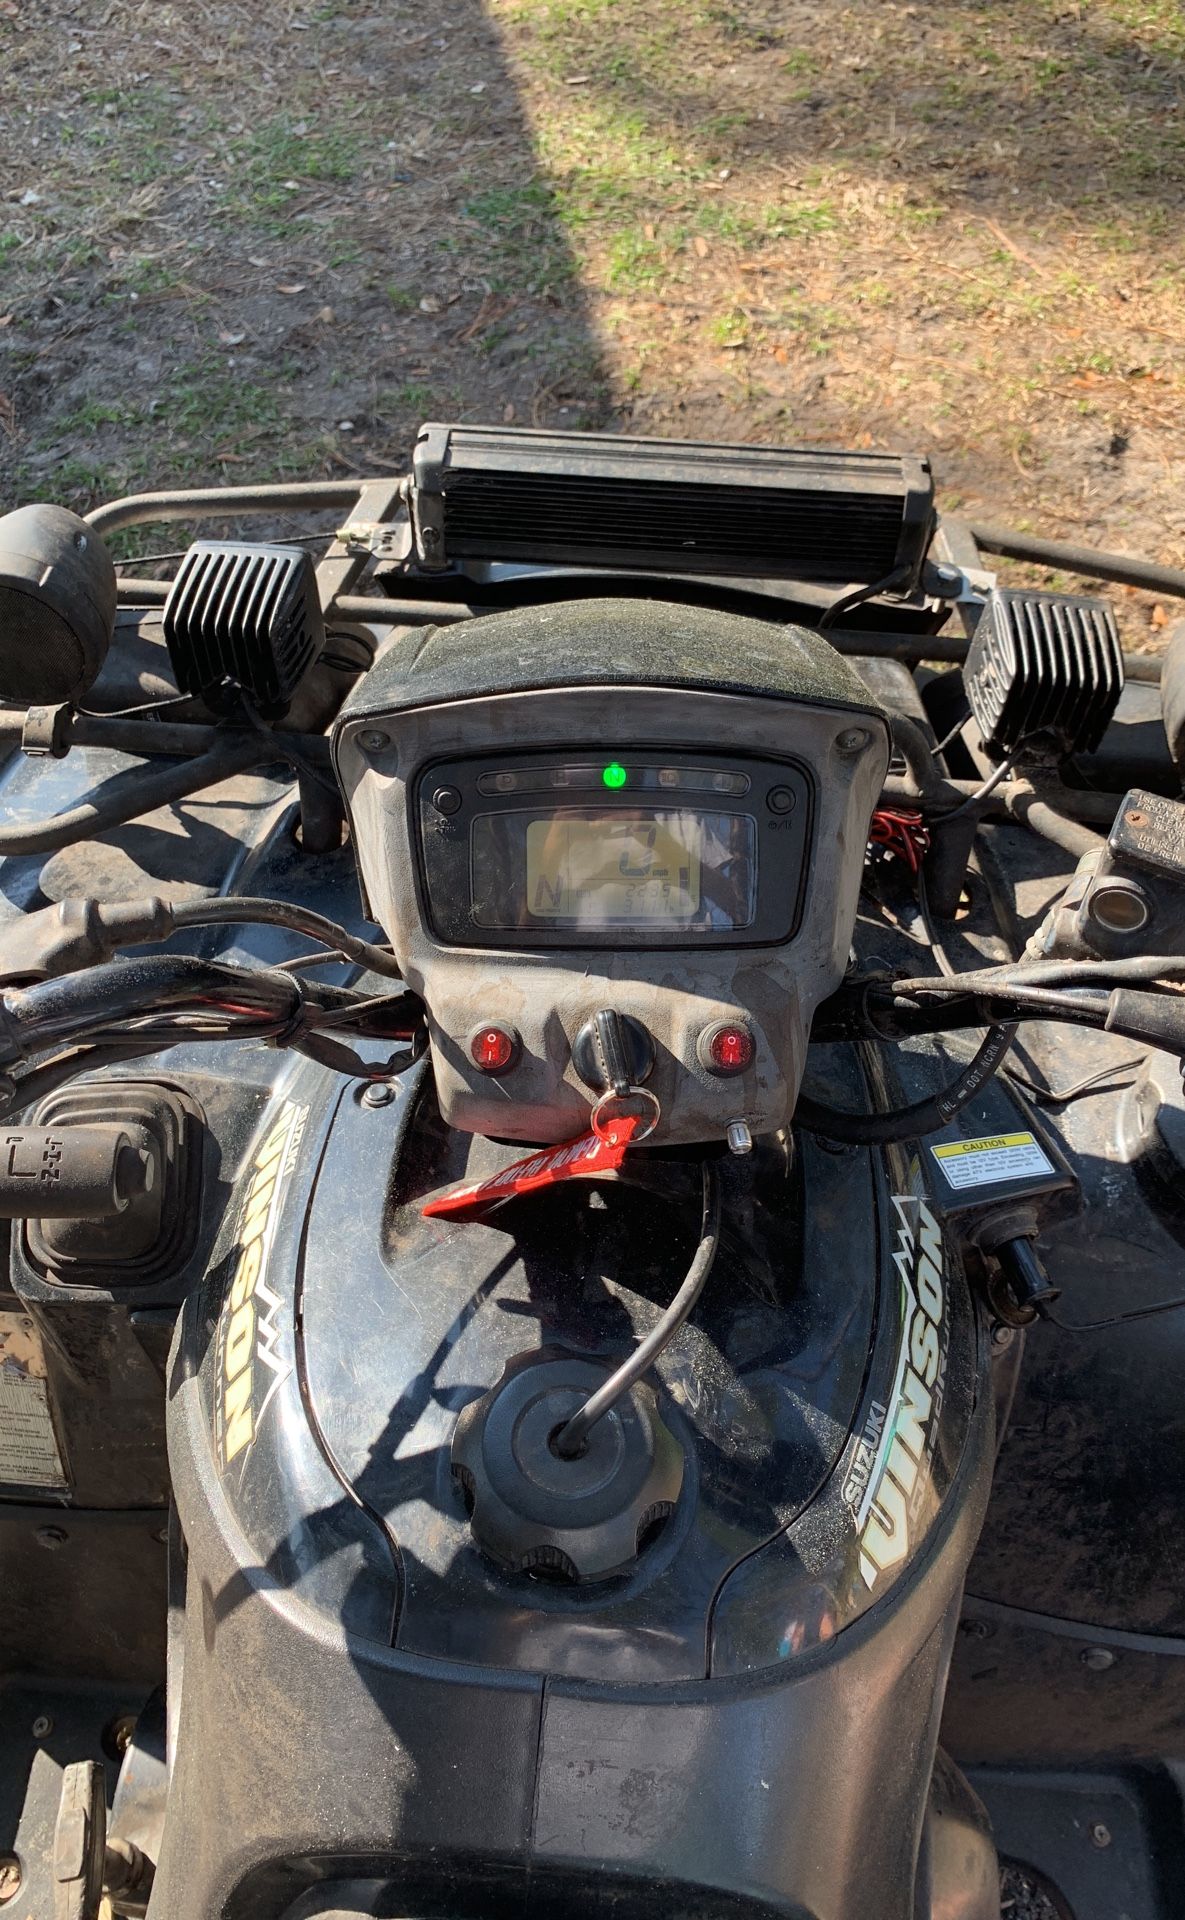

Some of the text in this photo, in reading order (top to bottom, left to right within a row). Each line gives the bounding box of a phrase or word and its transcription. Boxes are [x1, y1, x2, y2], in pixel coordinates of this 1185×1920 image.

[1139, 794, 1156, 806] USE
[283, 1104, 311, 1178] SUZUKI
[962, 1139, 1007, 1152] CAUTION
[861, 1199, 944, 1572] VINSON
[845, 1400, 887, 1506] SUZUKI
